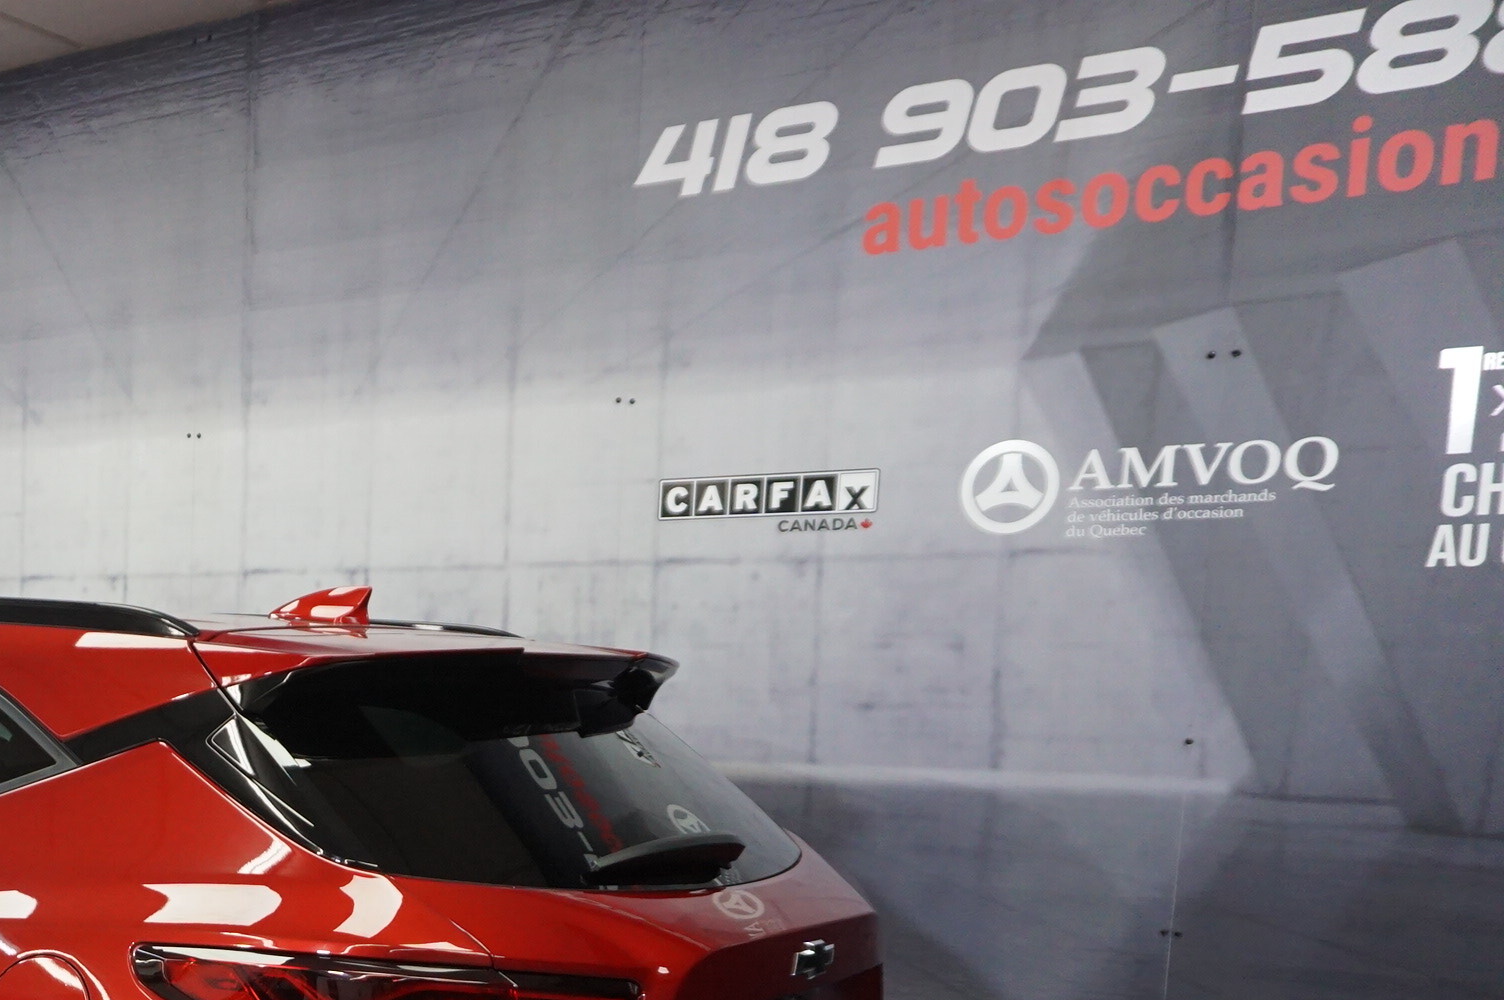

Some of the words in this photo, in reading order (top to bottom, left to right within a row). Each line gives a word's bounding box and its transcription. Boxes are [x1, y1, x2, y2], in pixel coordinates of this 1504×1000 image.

[632, 100, 839, 197] 418
[872, 0, 1504, 169] 903-58
[862, 115, 1499, 255] autosoccasion
[1068, 436, 1339, 491] AMVOQ
[664, 478, 871, 516] CARFAX
[1067, 510, 1083, 523] de
[1163, 506, 1244, 520] d'occasion
[1068, 493, 1154, 508] Association
[1158, 491, 1185, 506] des
[1188, 489, 1277, 504] marchands
[777, 517, 858, 533] CANADA
[1066, 525, 1085, 537] du
[1424, 523, 1491, 567] AU
